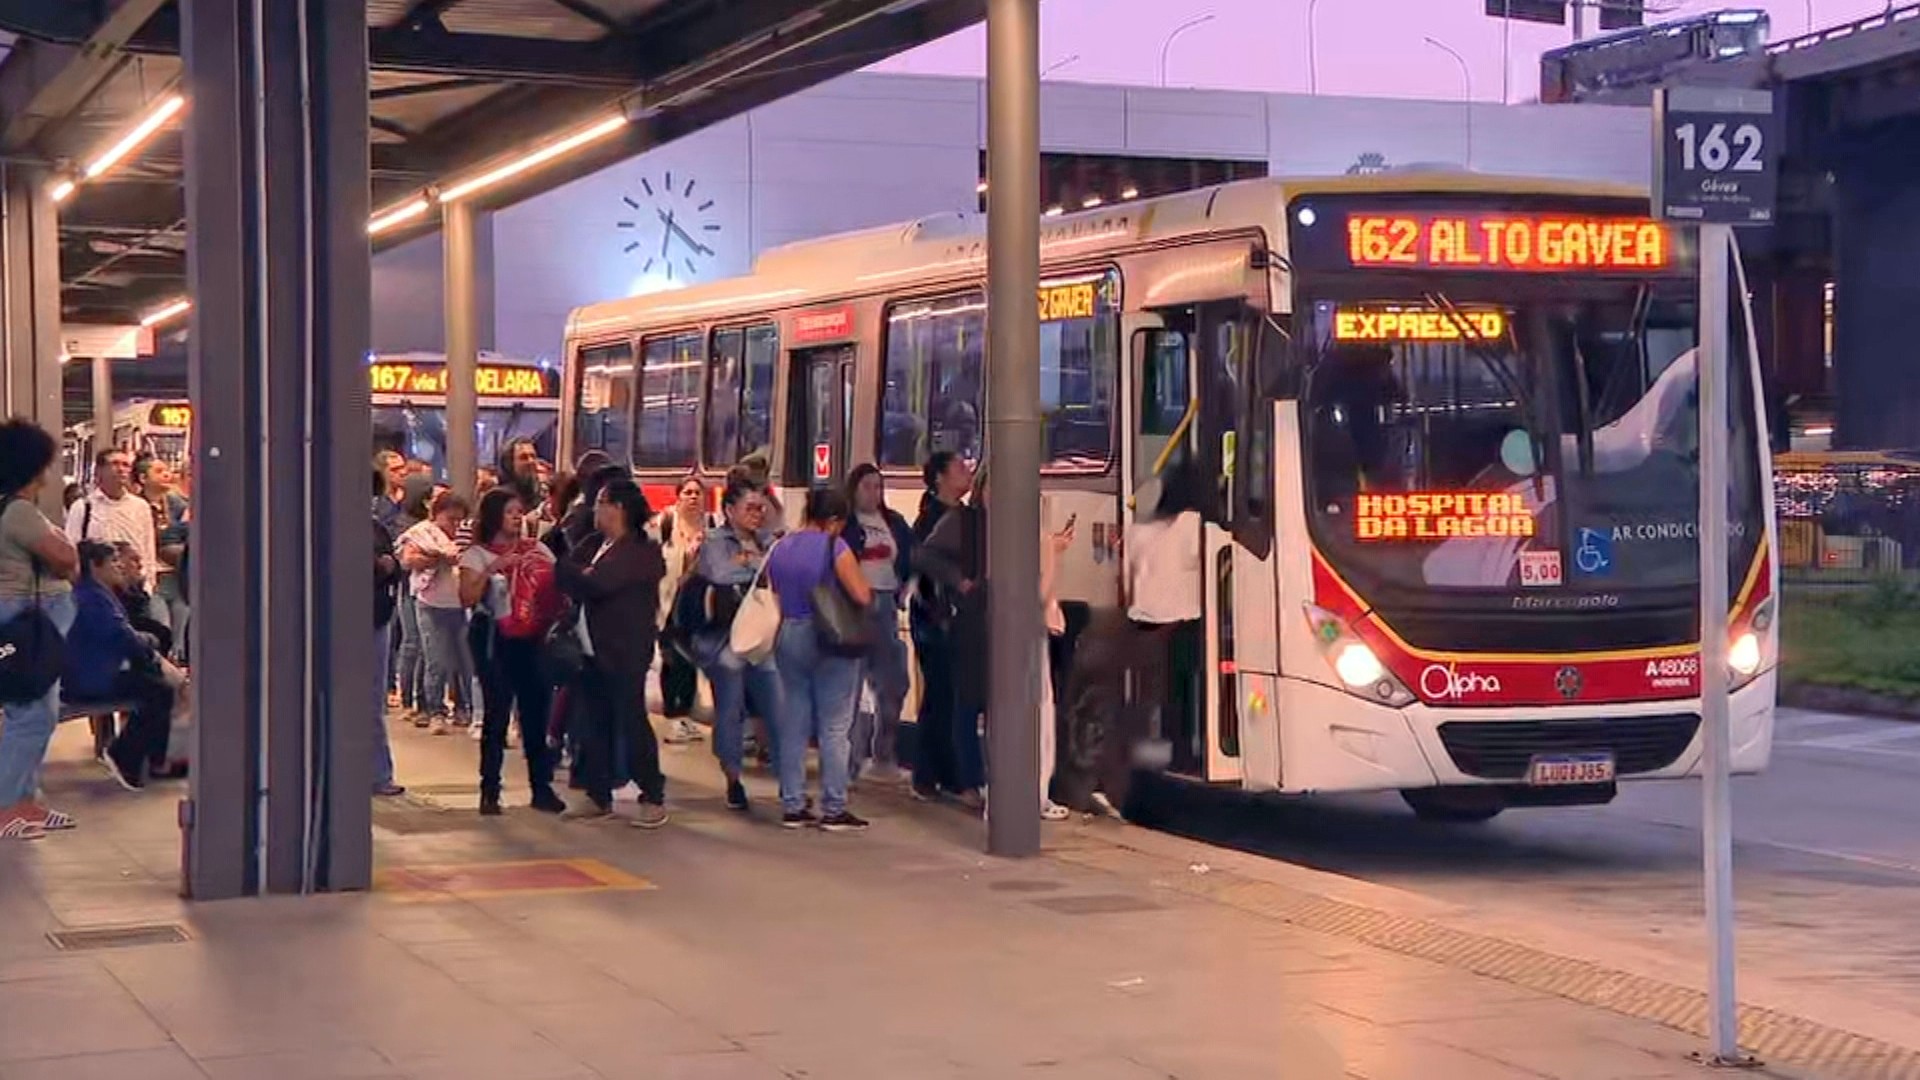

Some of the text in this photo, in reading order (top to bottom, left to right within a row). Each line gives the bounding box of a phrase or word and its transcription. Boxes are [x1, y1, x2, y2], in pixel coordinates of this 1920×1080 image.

[1675, 122, 1763, 172] 162
[1348, 218, 1662, 265] 162 ALTO GAVEA
[370, 364, 412, 391] 167
[412, 373, 437, 391] via
[160, 406, 191, 426] 167
[1357, 492, 1533, 517] HOSPITAL
[1358, 514, 1535, 538] DA LAGOA
[1611, 524, 1633, 541] AR
[1523, 563, 1560, 582] 5,00
